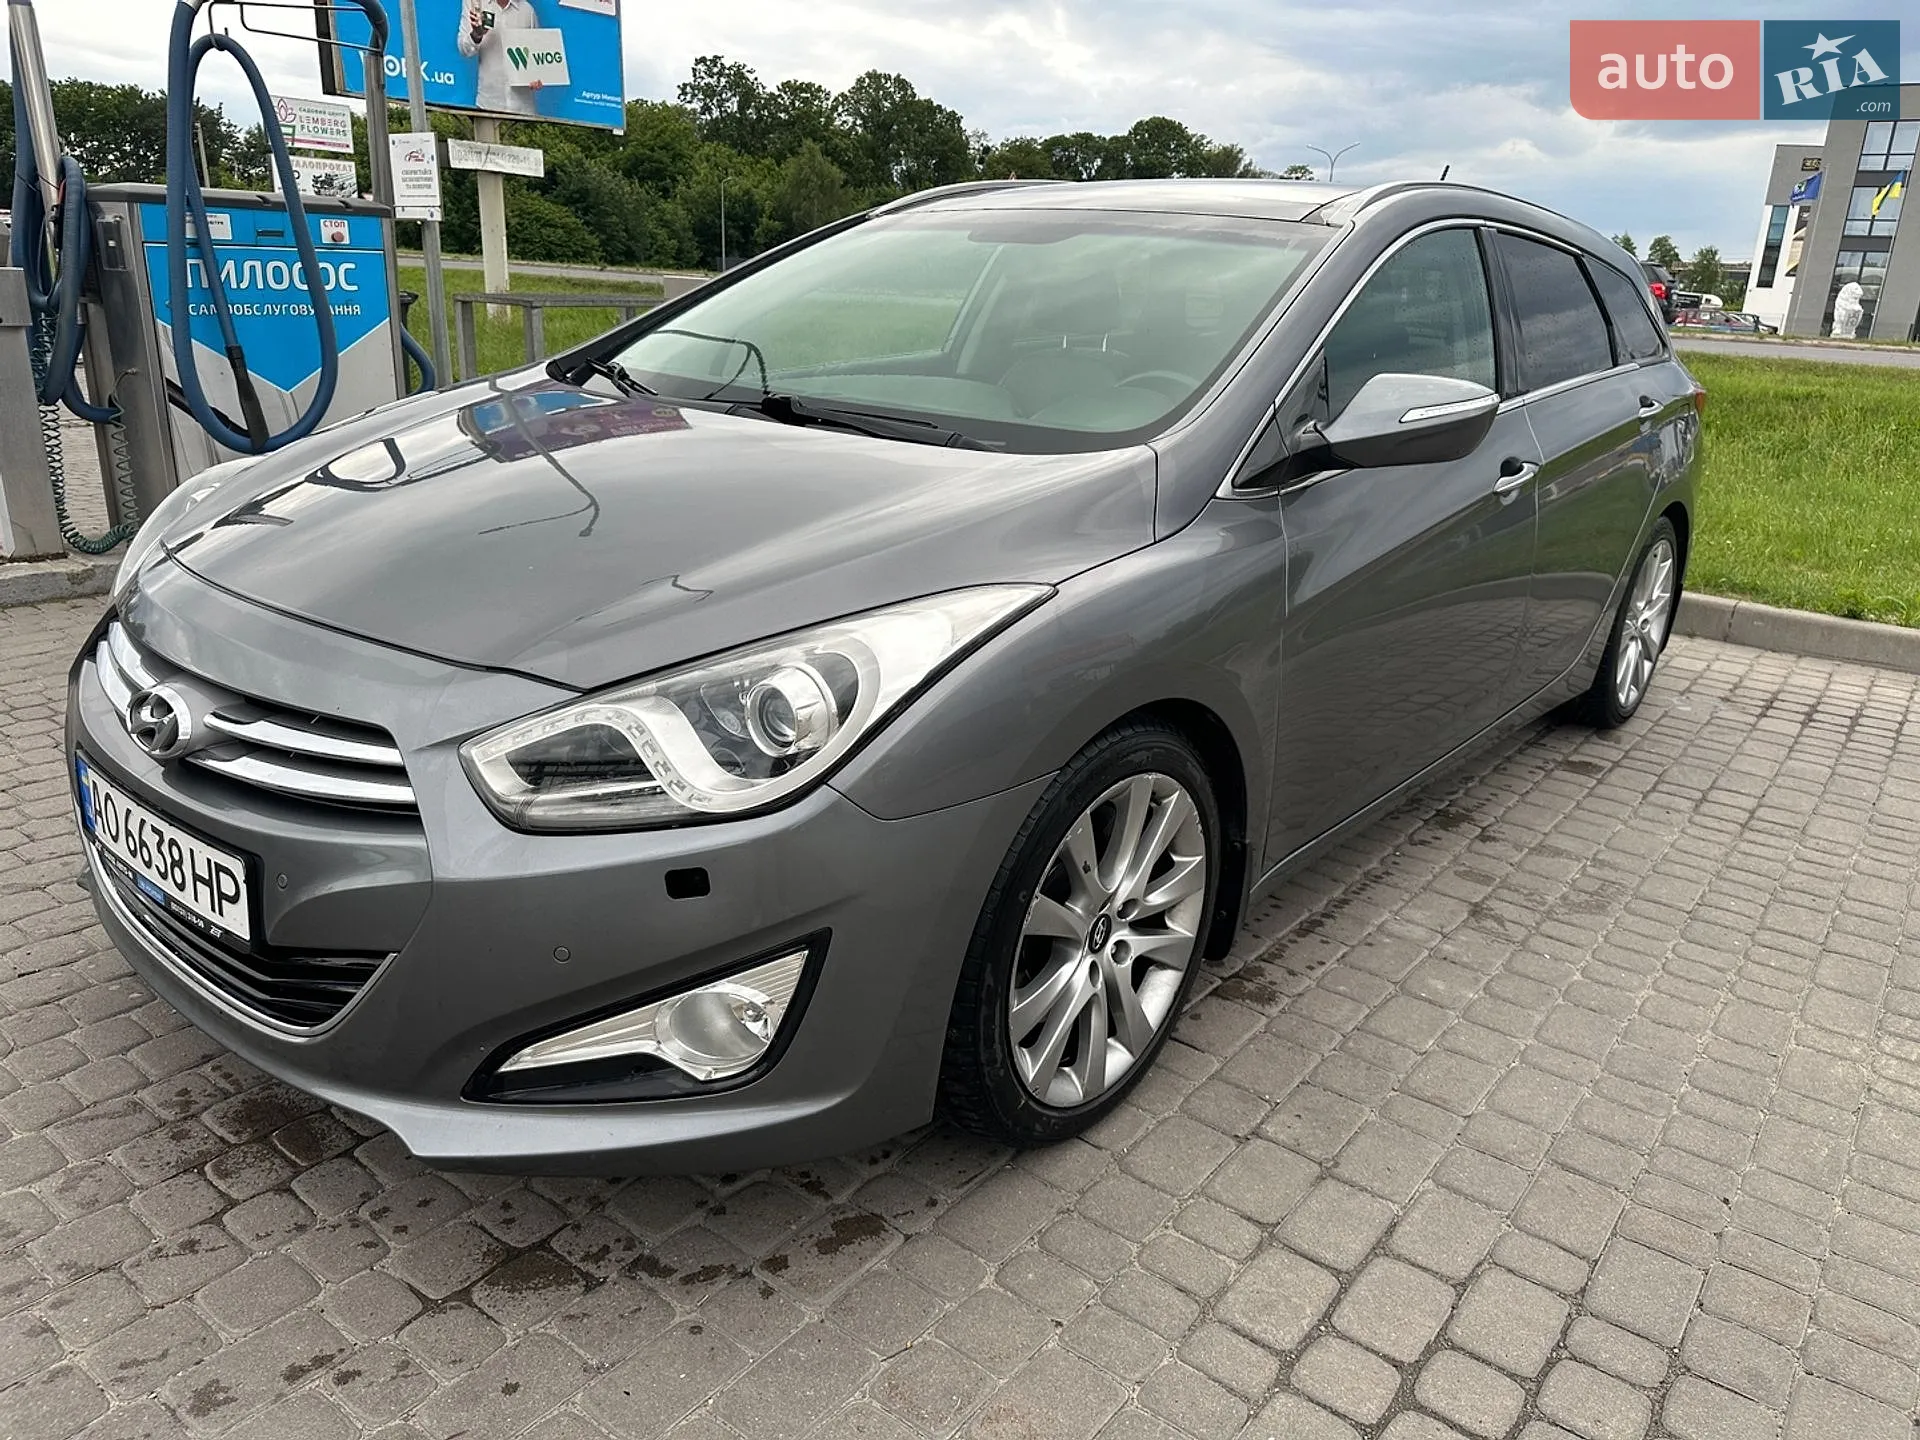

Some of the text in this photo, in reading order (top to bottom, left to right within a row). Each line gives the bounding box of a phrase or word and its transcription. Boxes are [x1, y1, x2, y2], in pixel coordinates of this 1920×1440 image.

[532, 52, 563, 66] WOG
[299, 115, 347, 128] LEMBERG
[300, 125, 347, 137] FLOWERS
[322, 220, 346, 228] СТОП
[186, 258, 359, 291] ПИЛОСОС
[124, 807, 187, 893] 6638
